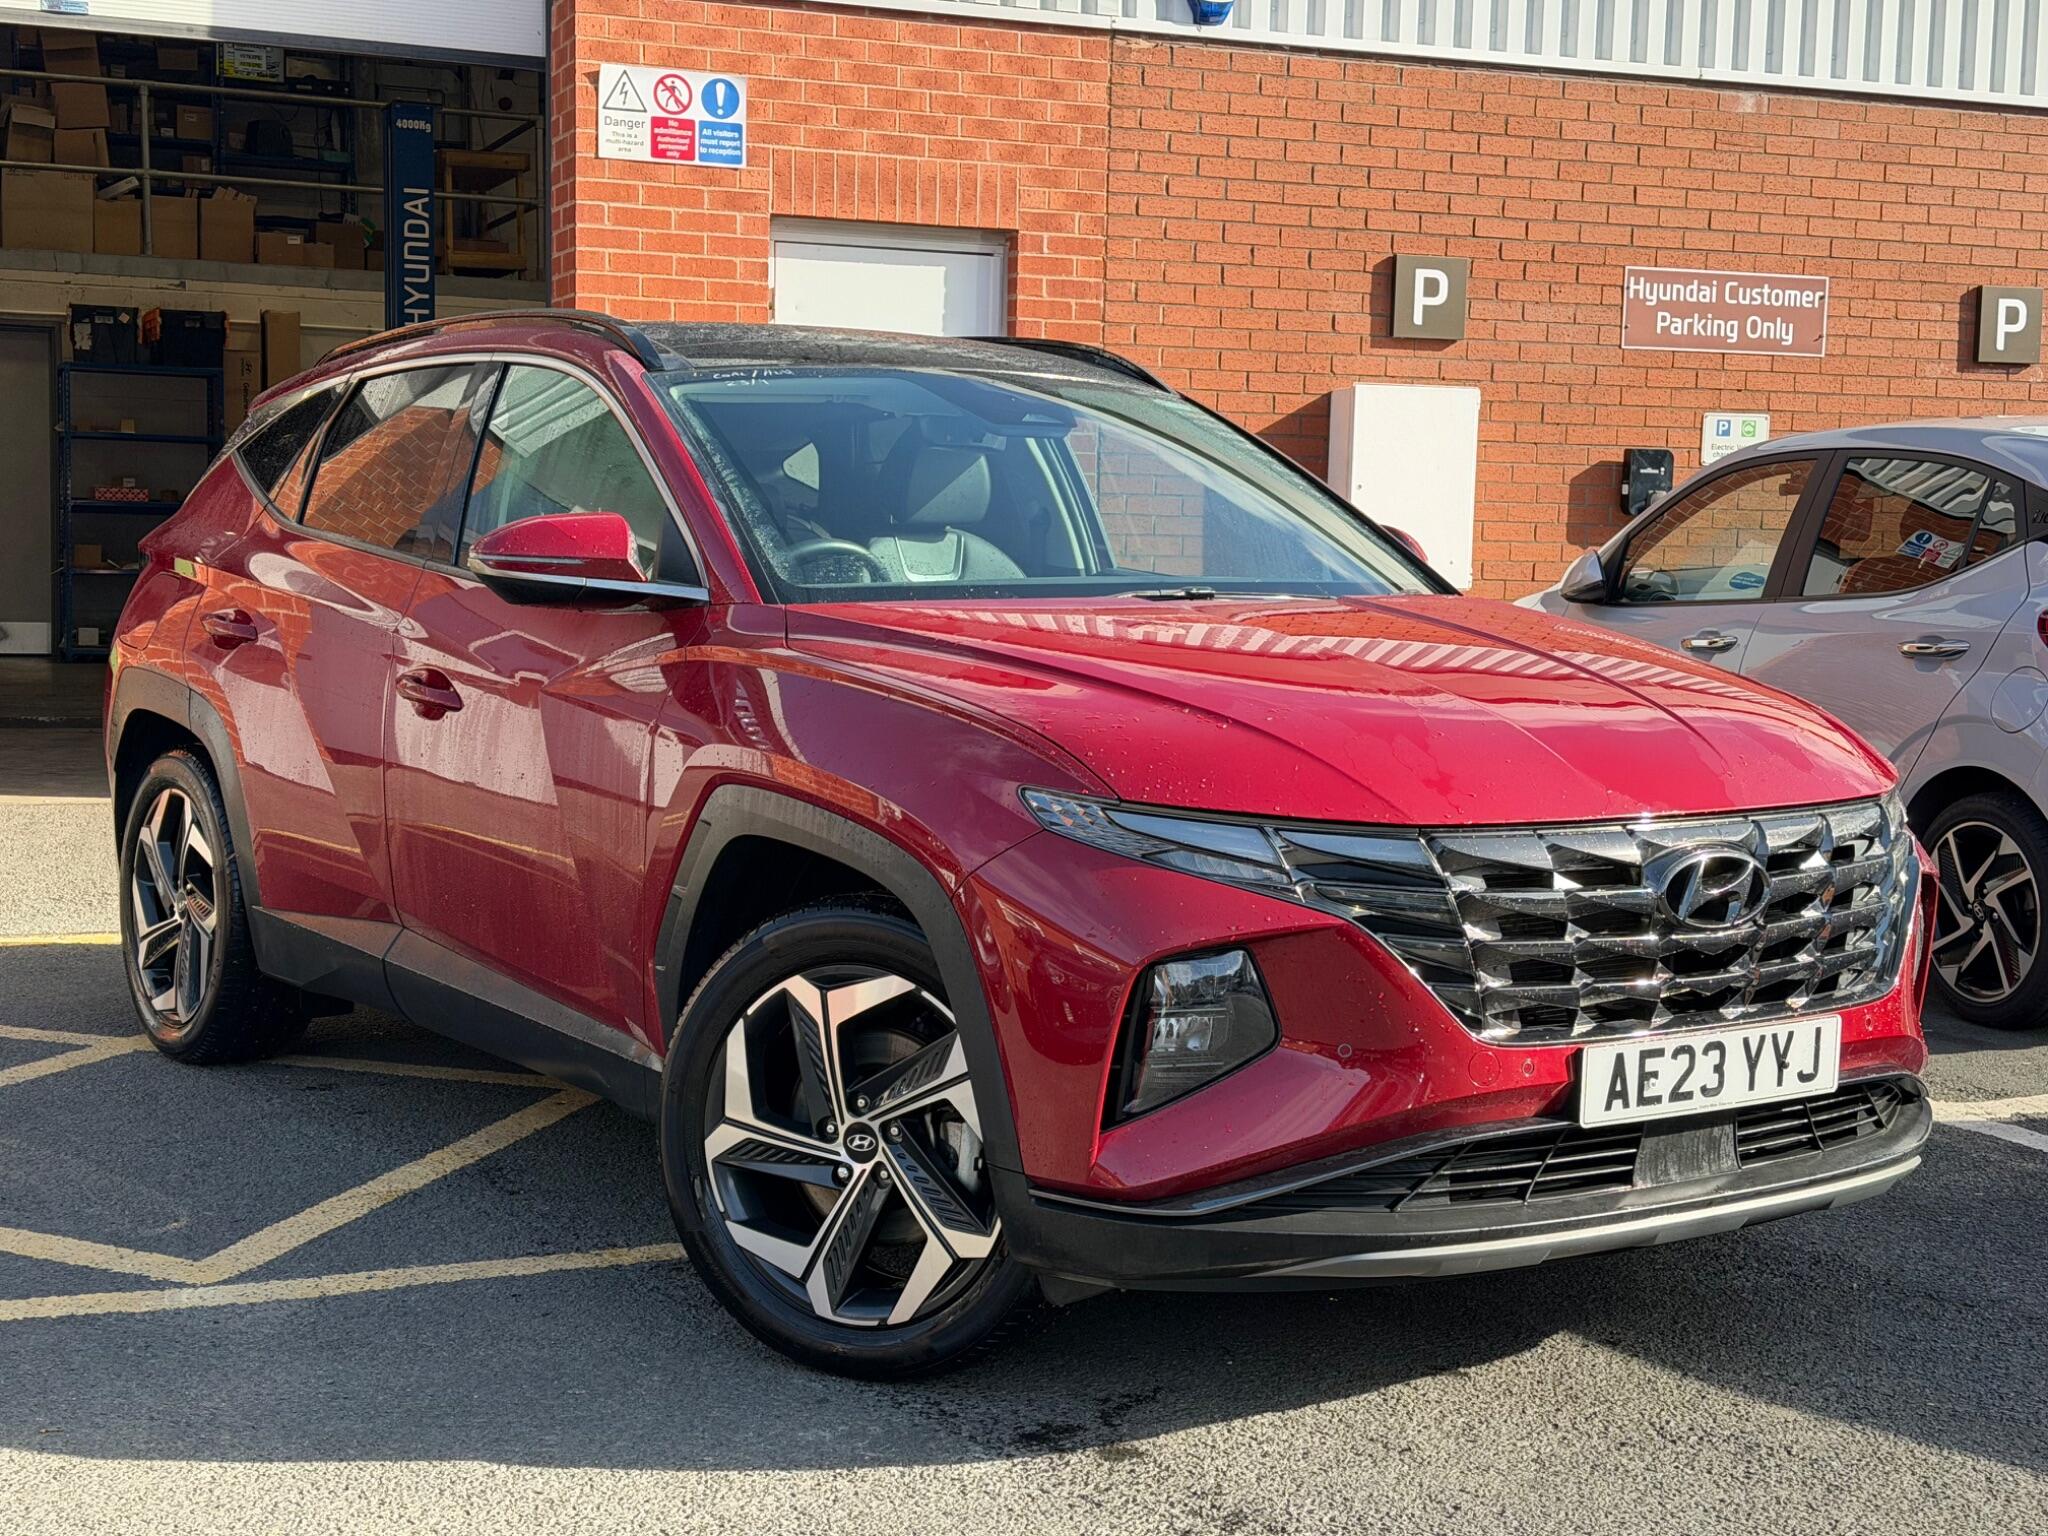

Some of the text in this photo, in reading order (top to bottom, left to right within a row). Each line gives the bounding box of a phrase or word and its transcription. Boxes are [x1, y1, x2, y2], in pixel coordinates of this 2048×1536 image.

[604, 115, 646, 130] Danger
[702, 128, 740, 138] All visitors
[605, 139, 645, 147] multi-hazard
[658, 143, 689, 151] personnel
[700, 138, 741, 148] must report
[666, 151, 680, 159] only
[708, 148, 742, 156] reception
[403, 187, 431, 326] HYUNDAI
[1413, 268, 1449, 326] P
[1629, 276, 1825, 308] Hyundai Customer
[1655, 311, 1794, 345] Parking Only
[1995, 298, 2027, 352] P
[1718, 422, 1729, 437] P
[1711, 443, 1735, 452] Electric
[1604, 1026, 1822, 1112] AE23 YYJ
